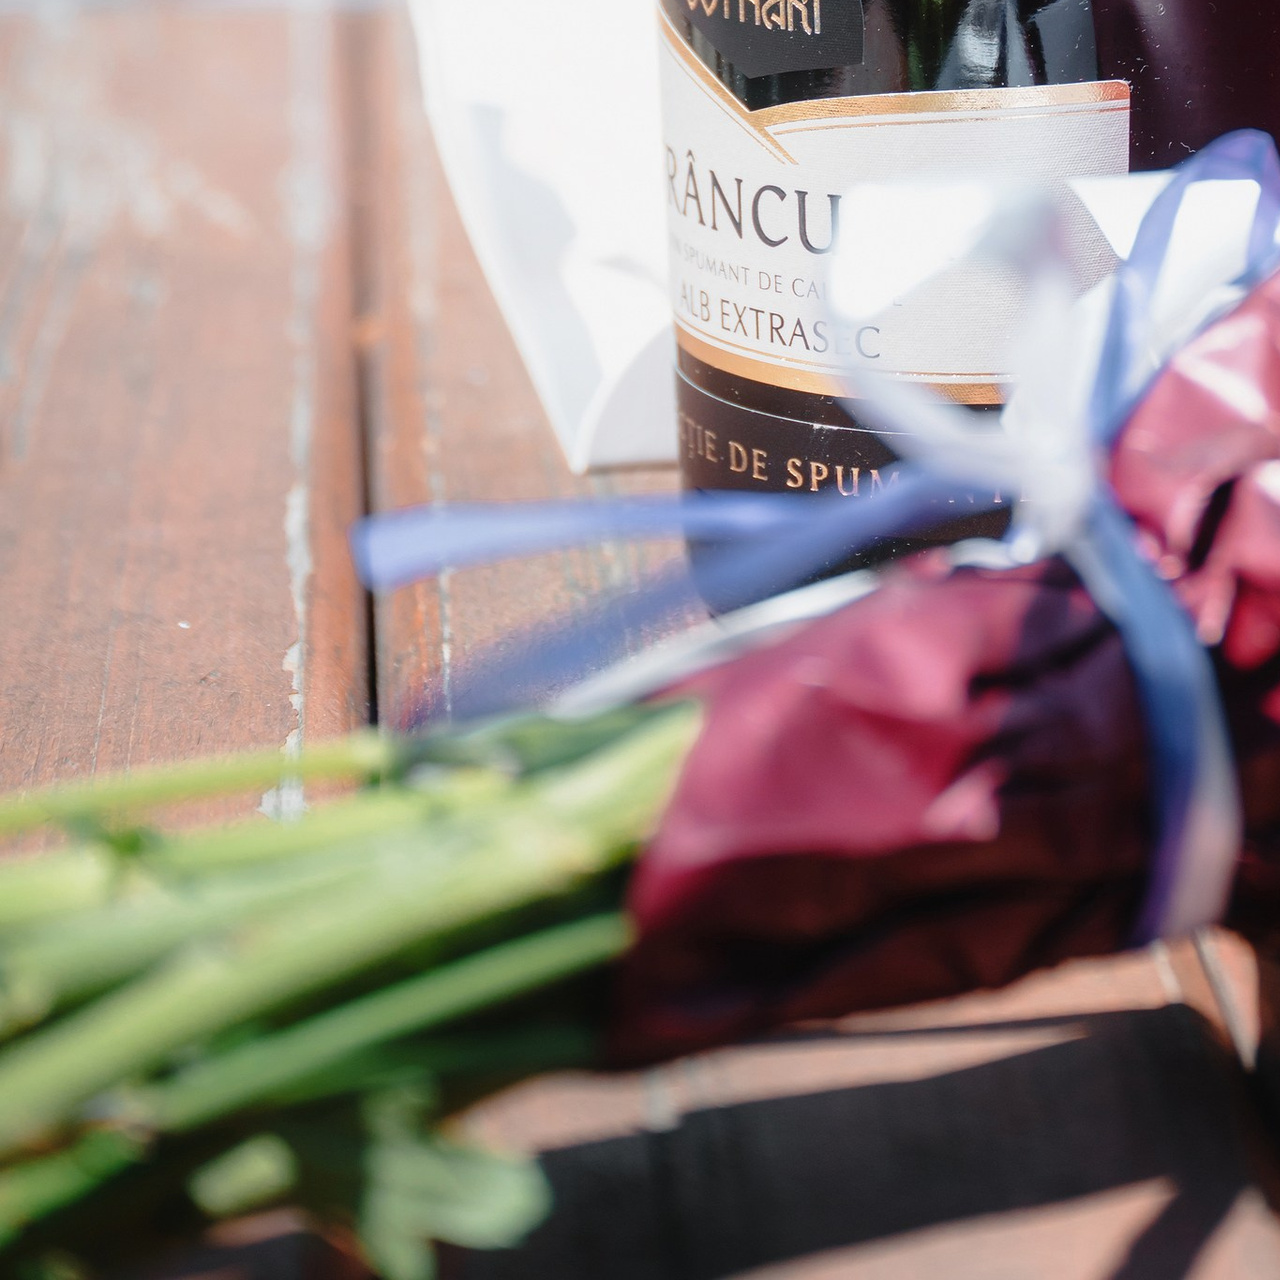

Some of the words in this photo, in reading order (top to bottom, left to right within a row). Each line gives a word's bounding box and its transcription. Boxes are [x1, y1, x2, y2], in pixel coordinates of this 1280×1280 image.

[666, 144, 842, 254] RÂNCU
[684, 242, 750, 286] SPUMANT
[758, 271, 783, 294] DE
[680, 278, 711, 322] ALB
[729, 440, 768, 482] DE
